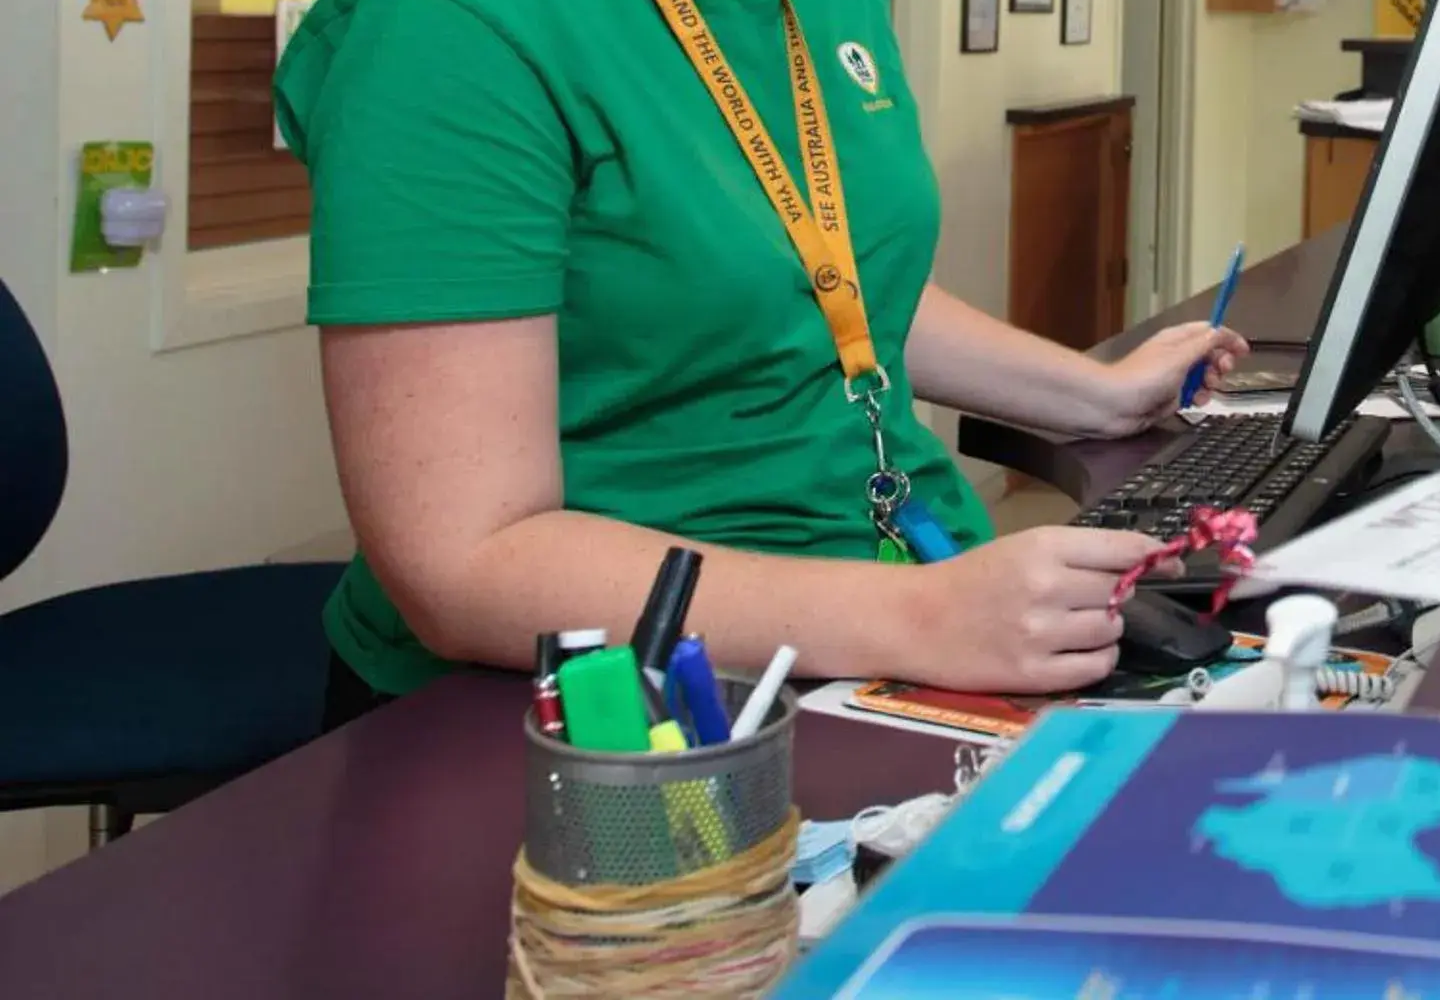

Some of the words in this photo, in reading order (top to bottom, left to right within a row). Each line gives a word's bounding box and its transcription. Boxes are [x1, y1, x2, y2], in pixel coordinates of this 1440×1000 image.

[794, 54, 812, 93] AND
[691, 30, 720, 65] THE
[711, 65, 755, 132] WORLD
[749, 133, 783, 182] WITH
[776, 183, 803, 224] YHA
[800, 98, 833, 197] AUSTRALIA
[818, 201, 840, 232] SEE
